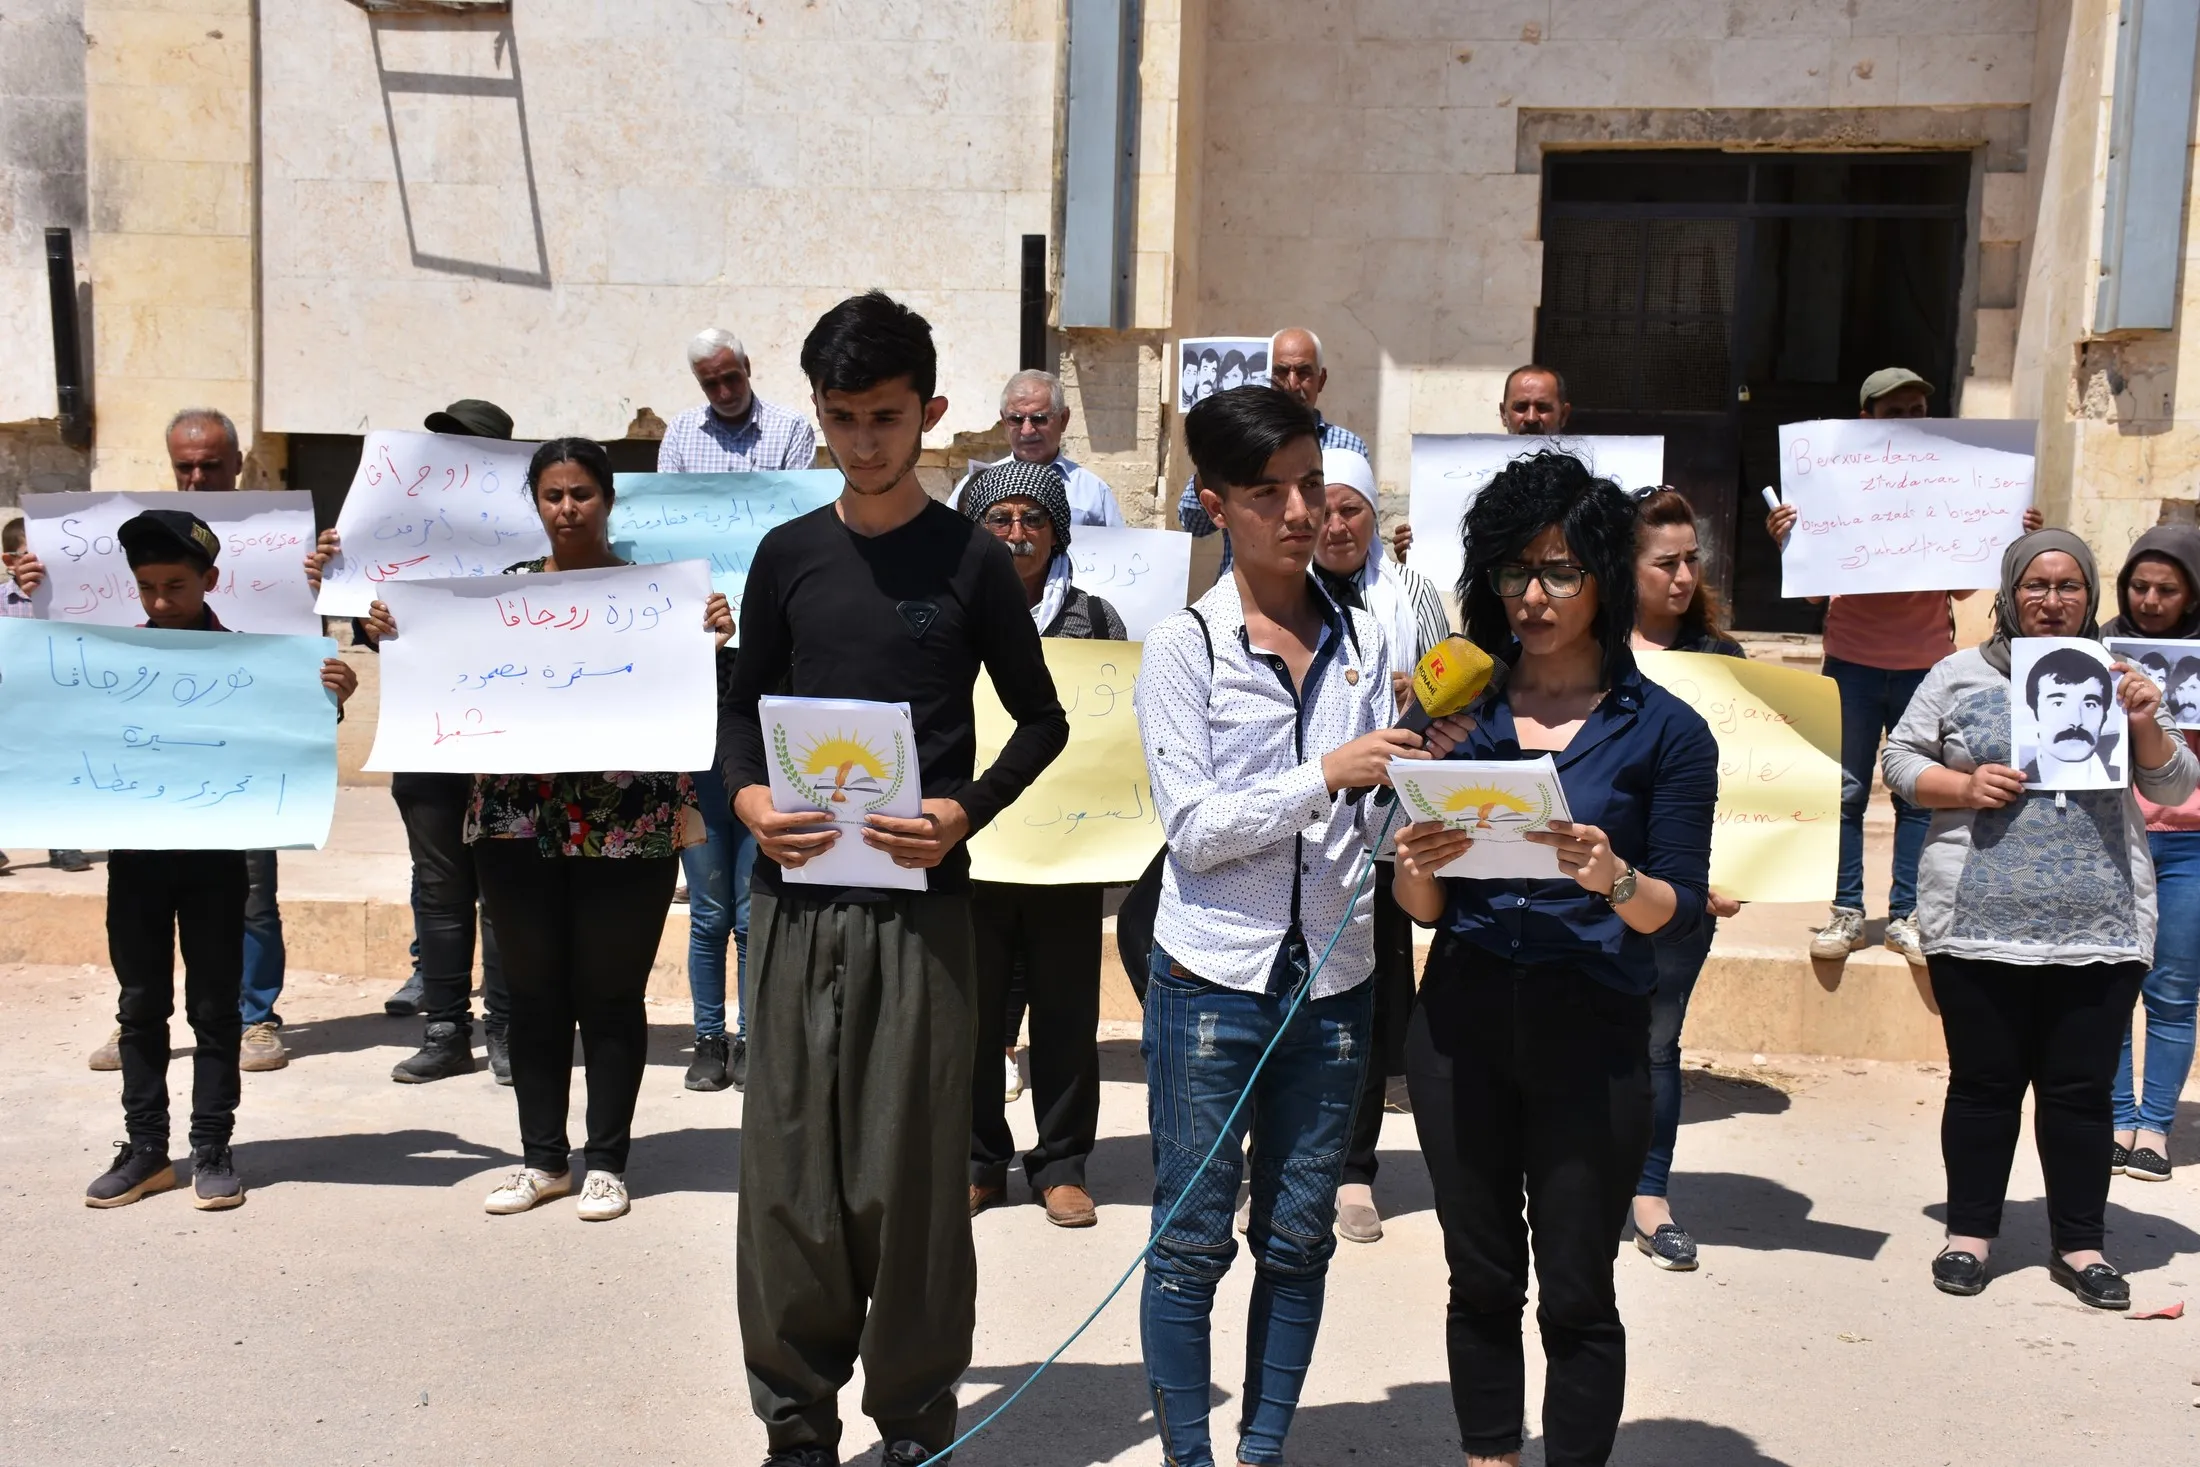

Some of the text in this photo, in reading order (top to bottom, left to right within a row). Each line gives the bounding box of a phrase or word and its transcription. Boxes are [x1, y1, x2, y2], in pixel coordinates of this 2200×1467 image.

[204, 569, 238, 599] ad
[605, 583, 673, 633] ثورة
[172, 666, 254, 708] ثورة
[1066, 663, 1137, 717] ثور
[1716, 747, 1797, 793] elê
